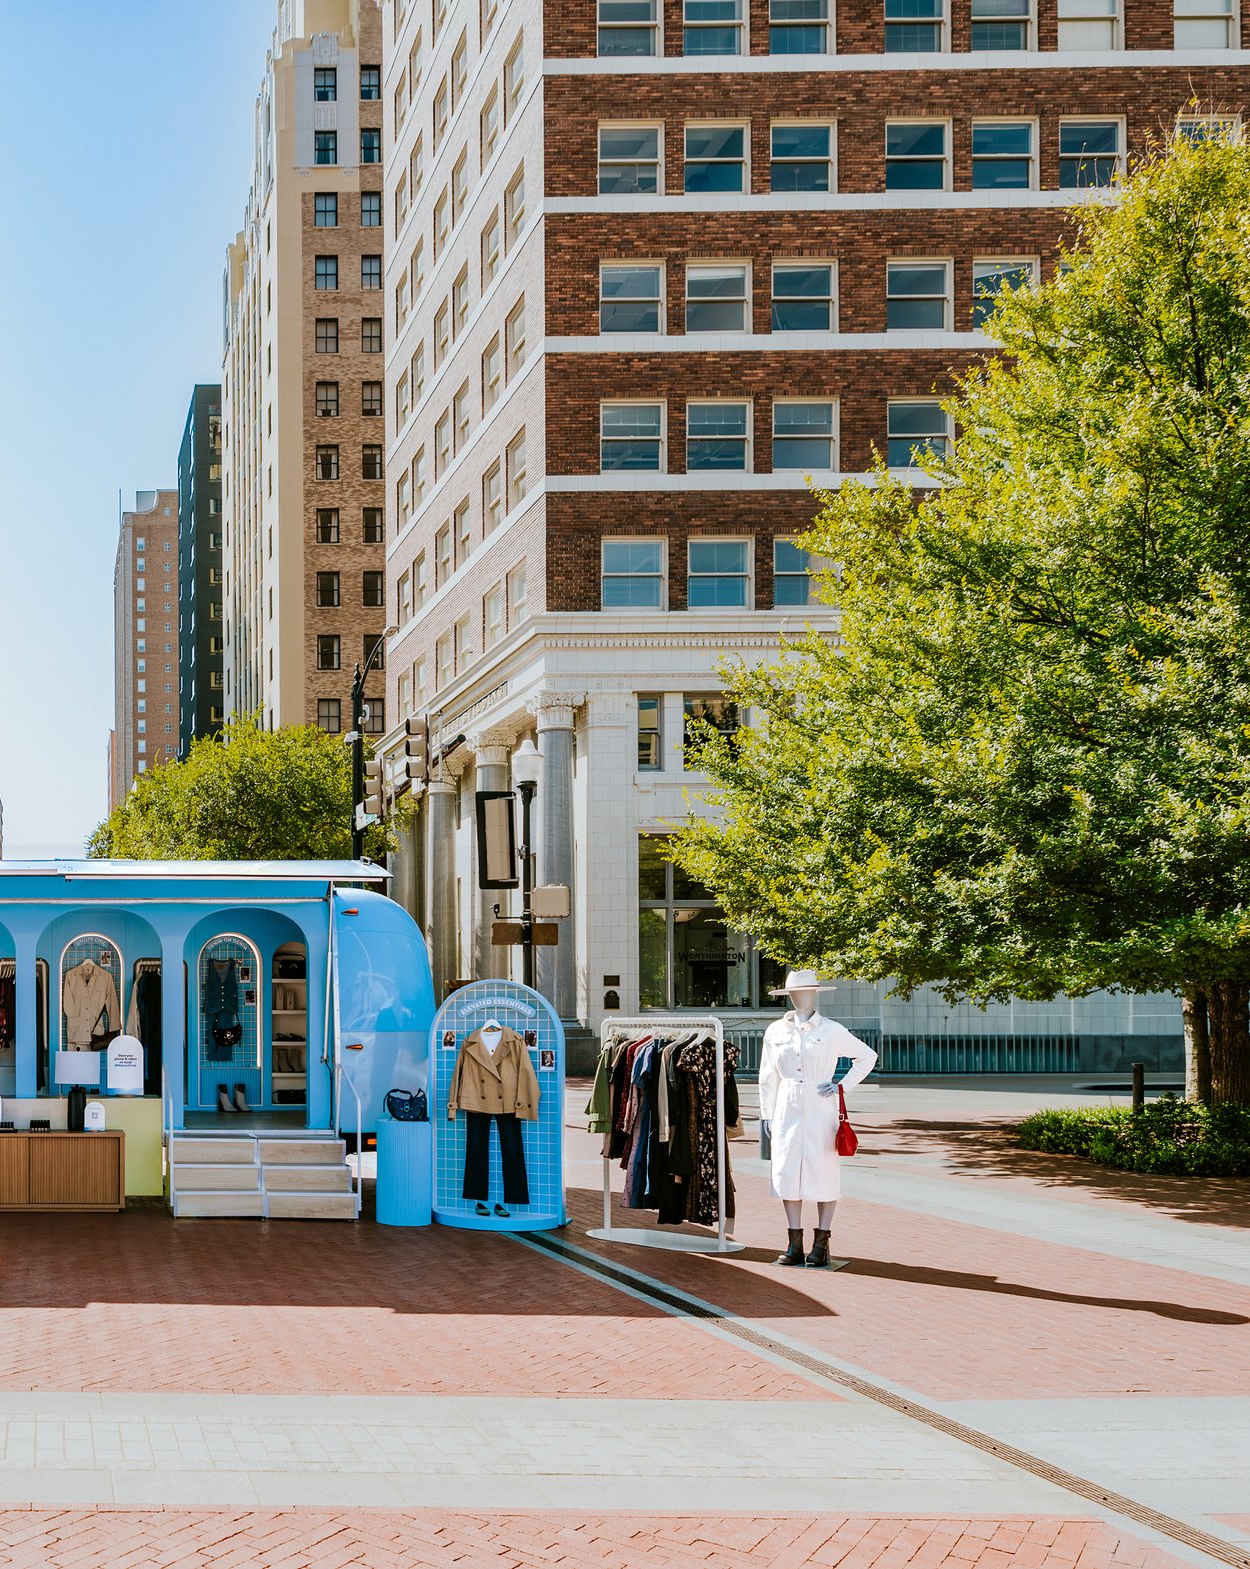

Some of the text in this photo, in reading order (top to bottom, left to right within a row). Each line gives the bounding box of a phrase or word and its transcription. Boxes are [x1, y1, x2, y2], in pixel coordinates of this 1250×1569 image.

[678, 952, 746, 963] WORTHINGTON
[460, 999, 532, 1015] ELEVATED ESSENTIALS
